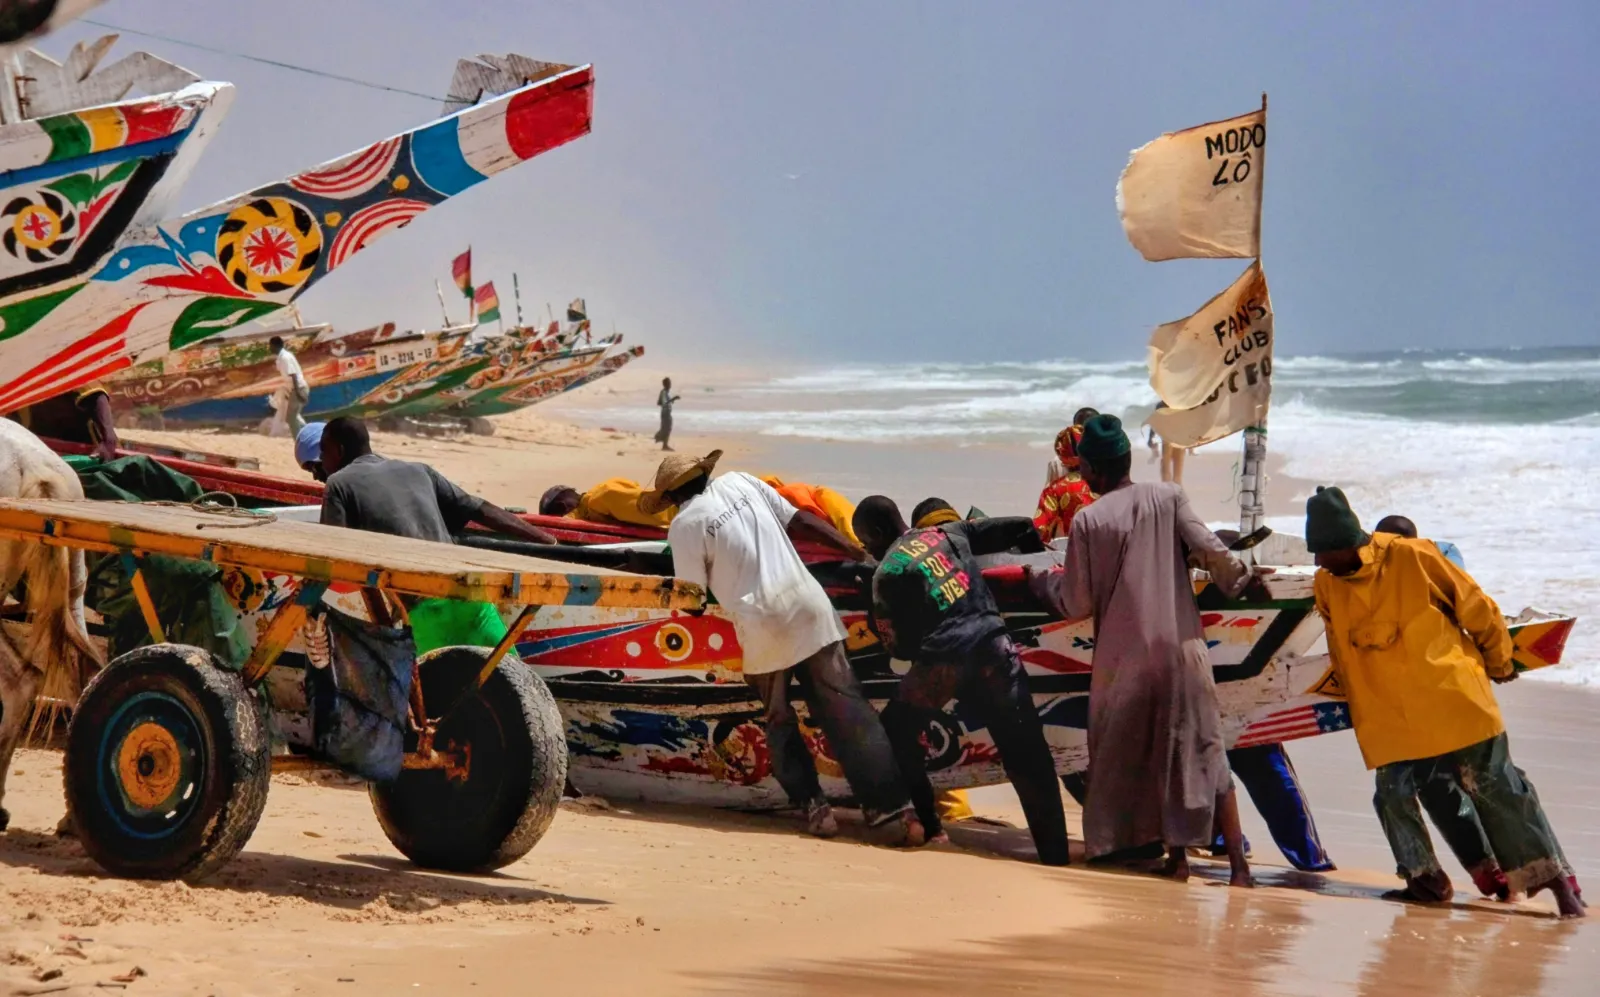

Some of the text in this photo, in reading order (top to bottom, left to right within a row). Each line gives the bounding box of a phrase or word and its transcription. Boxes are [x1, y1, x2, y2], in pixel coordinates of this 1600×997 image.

[1205, 123, 1266, 159] MODO
[1213, 298, 1266, 347] FANS
[1223, 330, 1269, 366] CLUB
[917, 551, 954, 584] FOR
[930, 570, 970, 611] EVER
